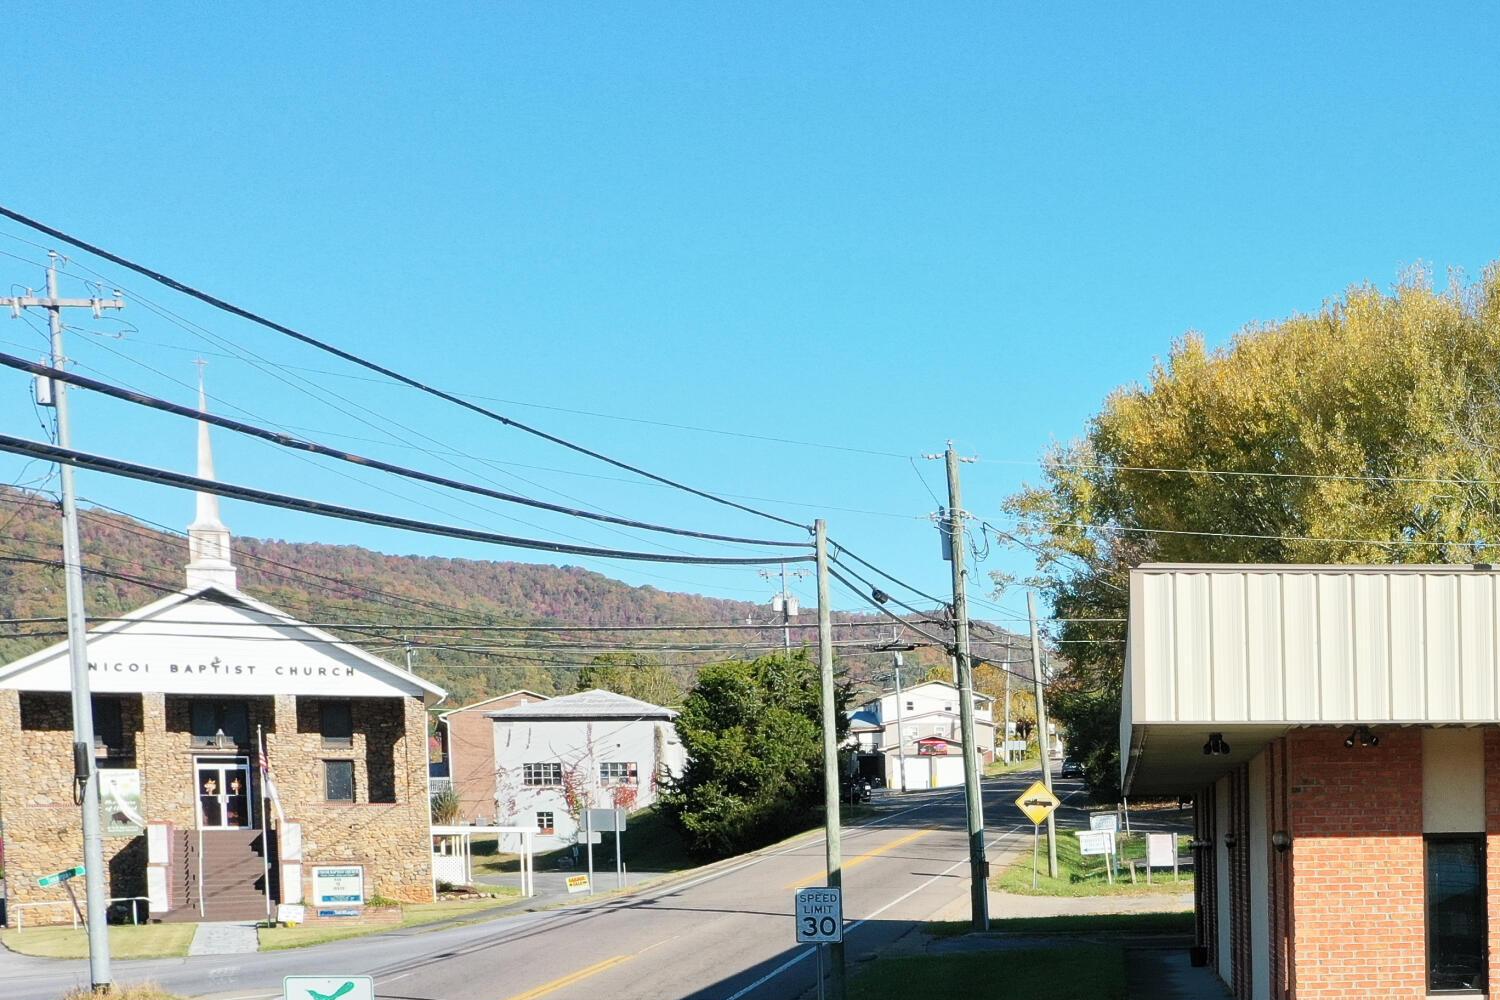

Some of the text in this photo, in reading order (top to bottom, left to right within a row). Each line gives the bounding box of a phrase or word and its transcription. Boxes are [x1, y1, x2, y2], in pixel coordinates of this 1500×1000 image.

[88, 662, 355, 677] NICOI BAPTIST CHURCH
[800, 894, 837, 902] SPEED
[804, 905, 833, 914] LIMIT
[802, 916, 836, 937] 30
